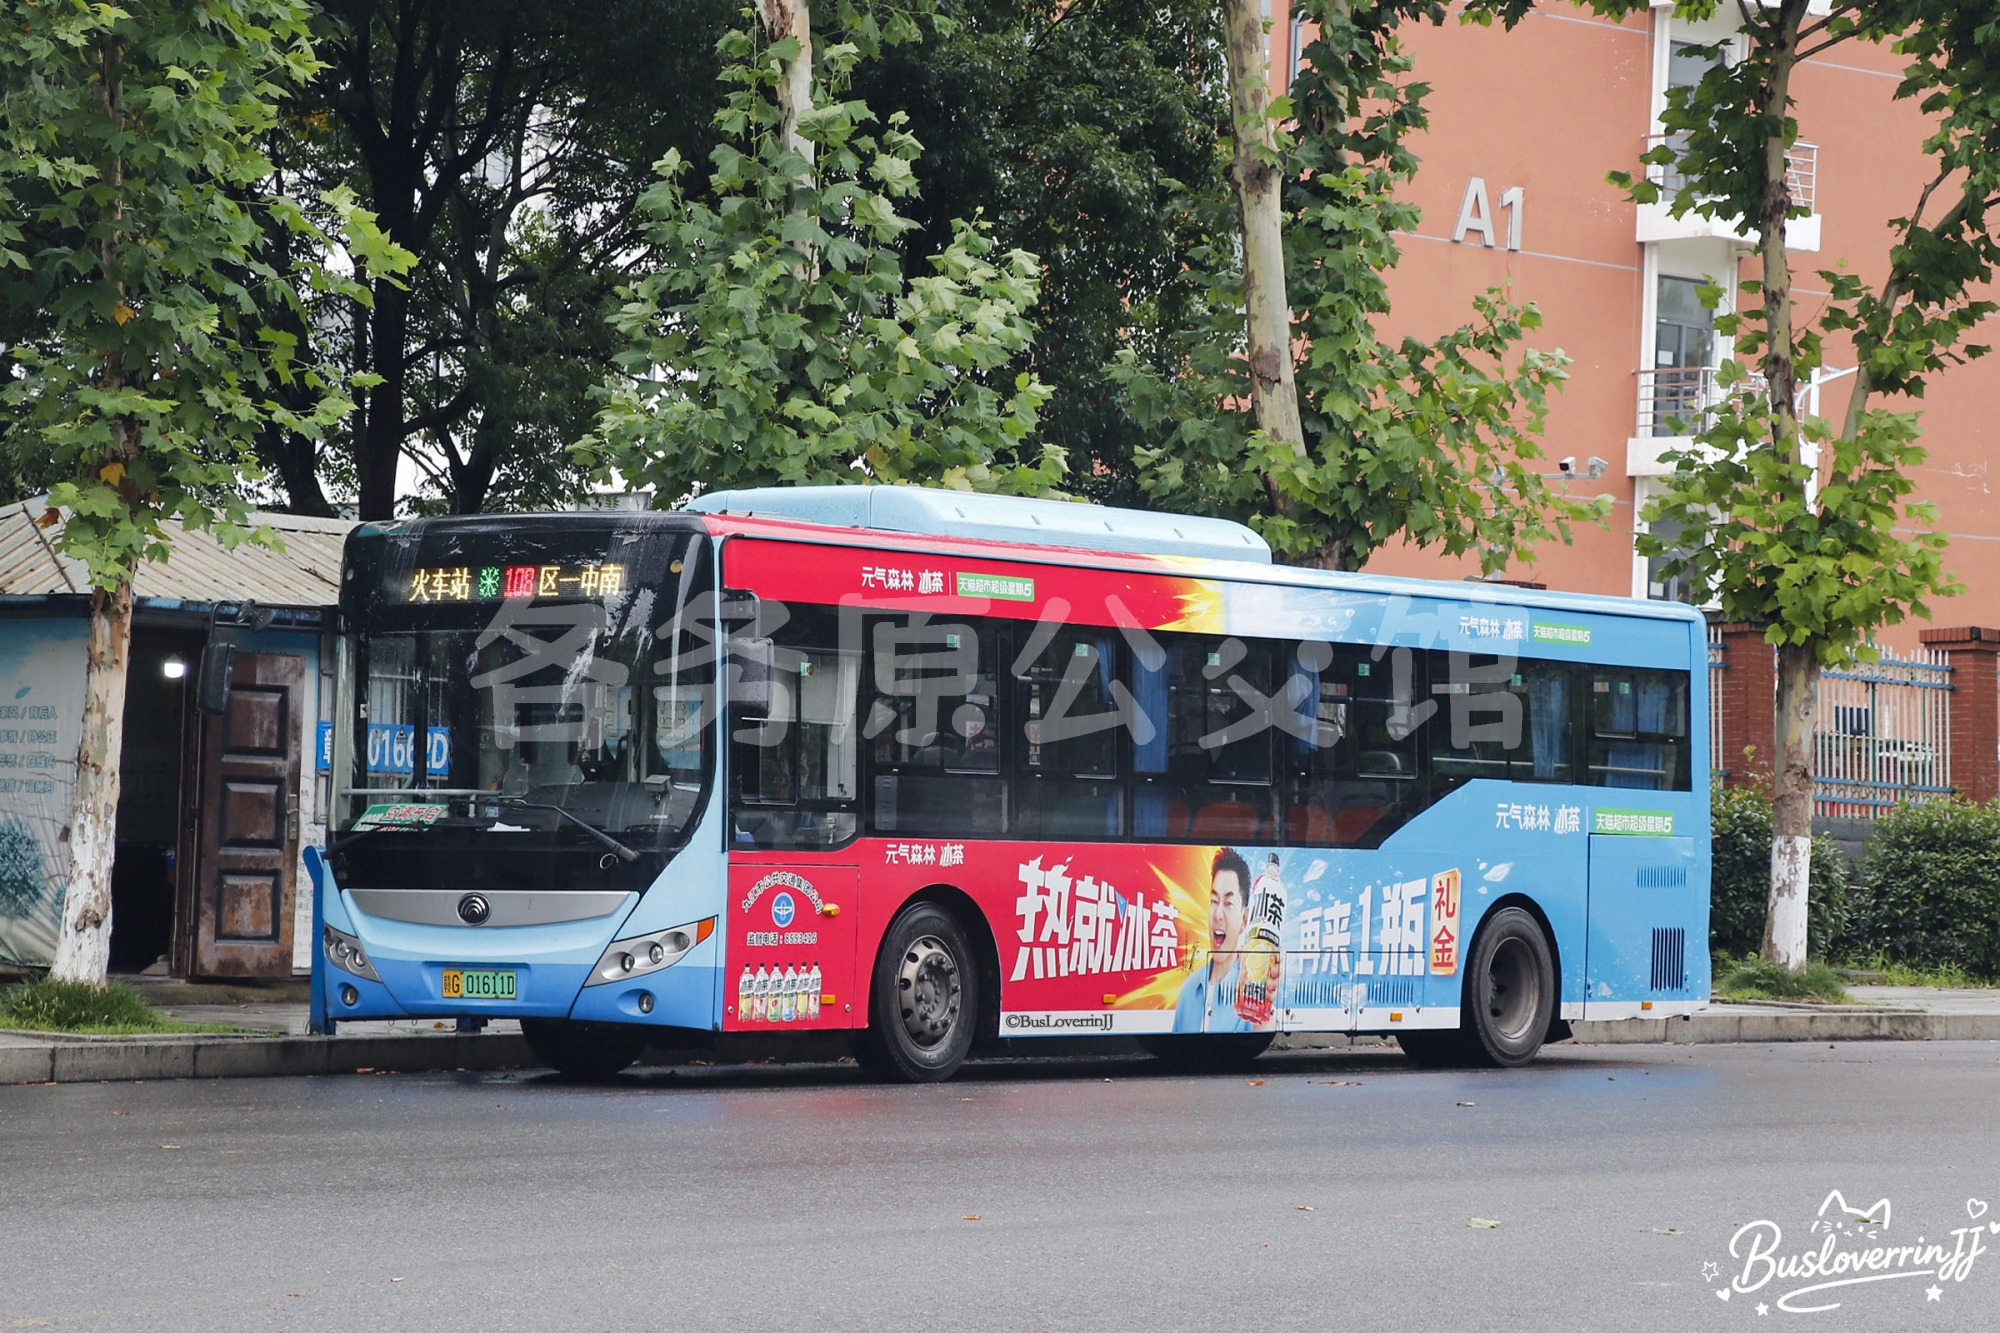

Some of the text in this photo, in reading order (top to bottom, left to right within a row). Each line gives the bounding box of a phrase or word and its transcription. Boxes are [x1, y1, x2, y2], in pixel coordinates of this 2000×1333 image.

[1451, 176, 1524, 252] A1
[409, 567, 472, 601] 火车站
[504, 567, 536, 598] 108
[861, 566, 1032, 597] 元气森林 冰茶 天猫超市超级星期5
[1459, 616, 1500, 638] 元气森林
[1496, 803, 1672, 835] 元气森林 冰茶 天猫超市超级星期5
[886, 842, 964, 867] 元气森林 冰茶
[1009, 854, 1180, 982] 热就冰茶
[1298, 877, 1427, 976] 再来1瓶
[1433, 877, 1456, 968] 礼金
